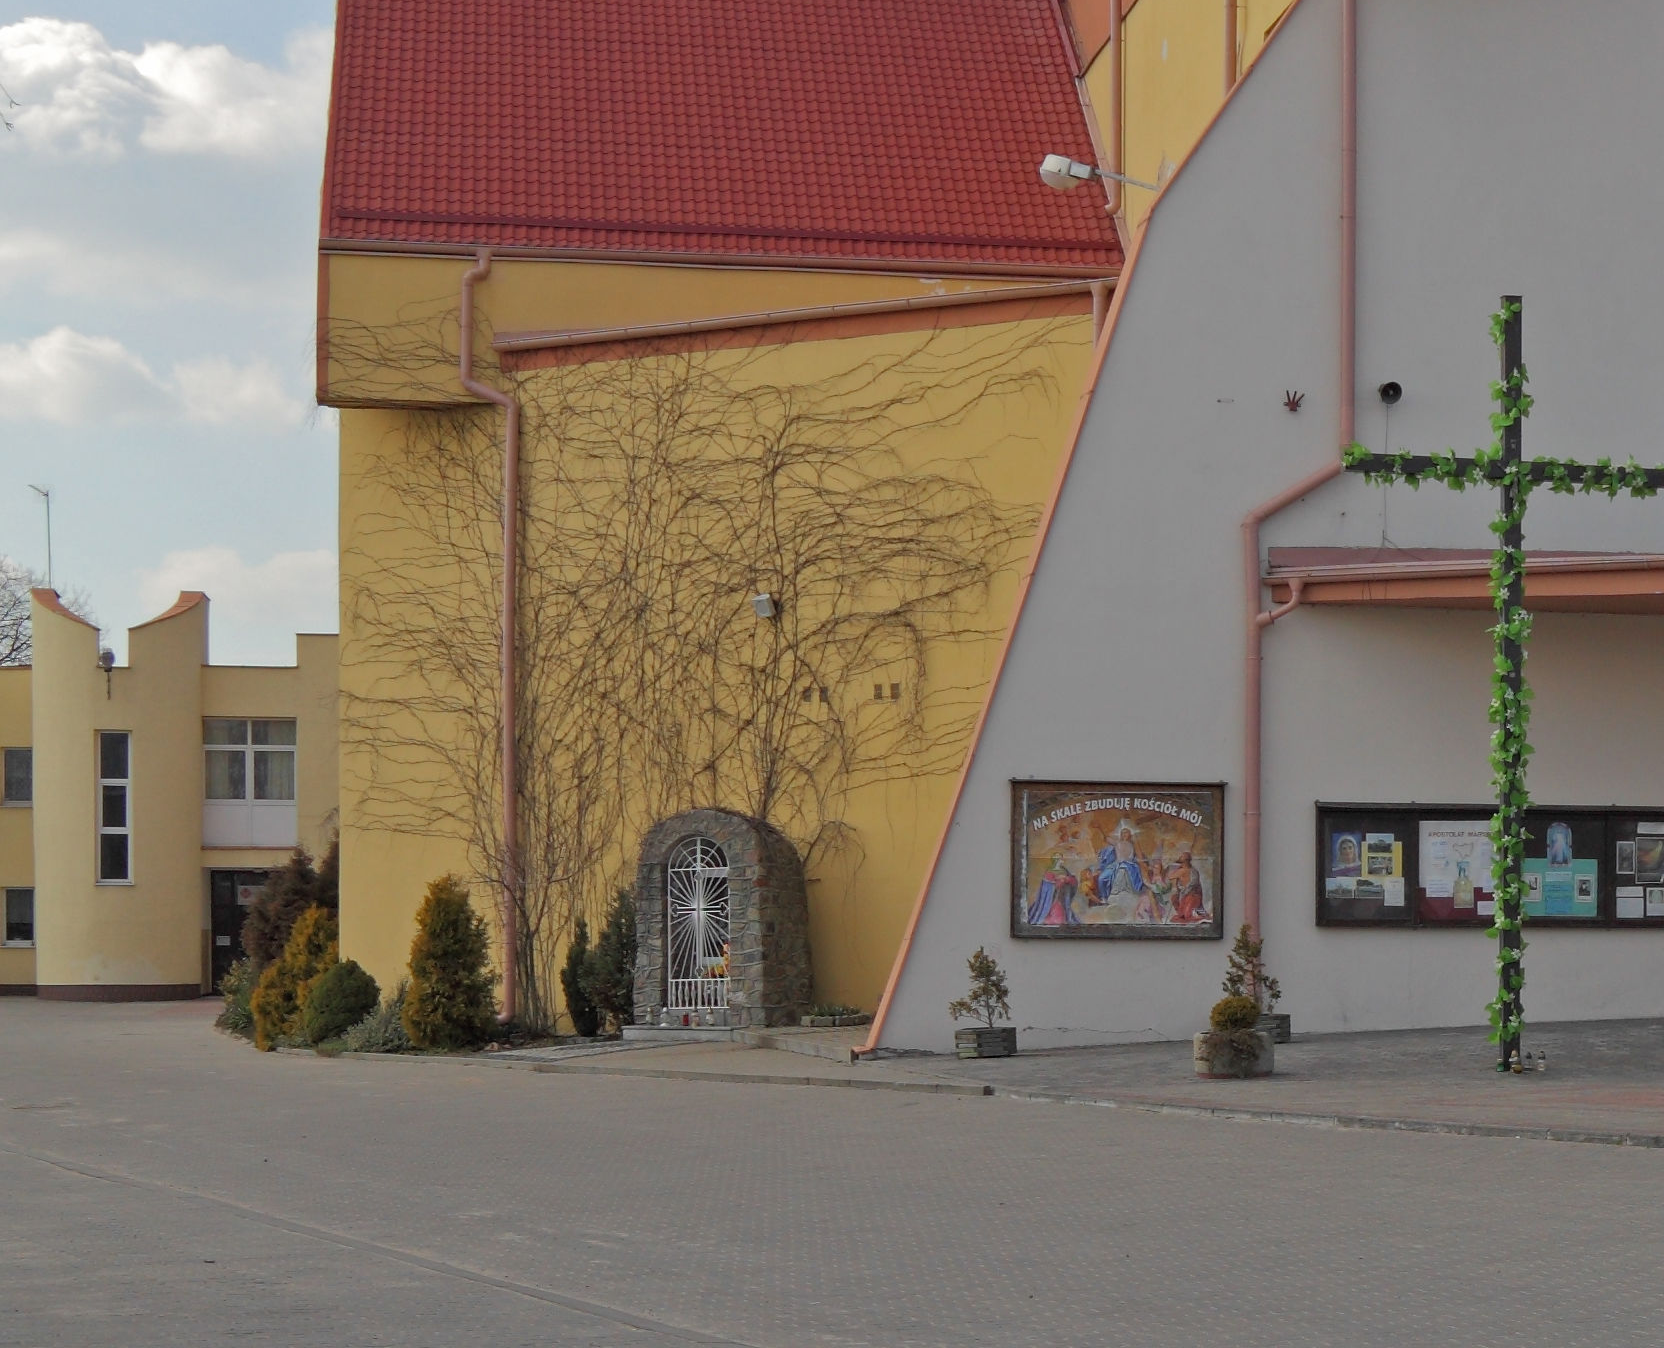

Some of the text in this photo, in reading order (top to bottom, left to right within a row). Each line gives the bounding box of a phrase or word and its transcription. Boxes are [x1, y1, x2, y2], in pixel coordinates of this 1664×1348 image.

[1032, 815, 1049, 830] NA
[1050, 803, 1082, 823] SKALE
[1085, 797, 1131, 812] ZBUDUJĘ
[1133, 797, 1178, 817] KOŚCIÓŁ
